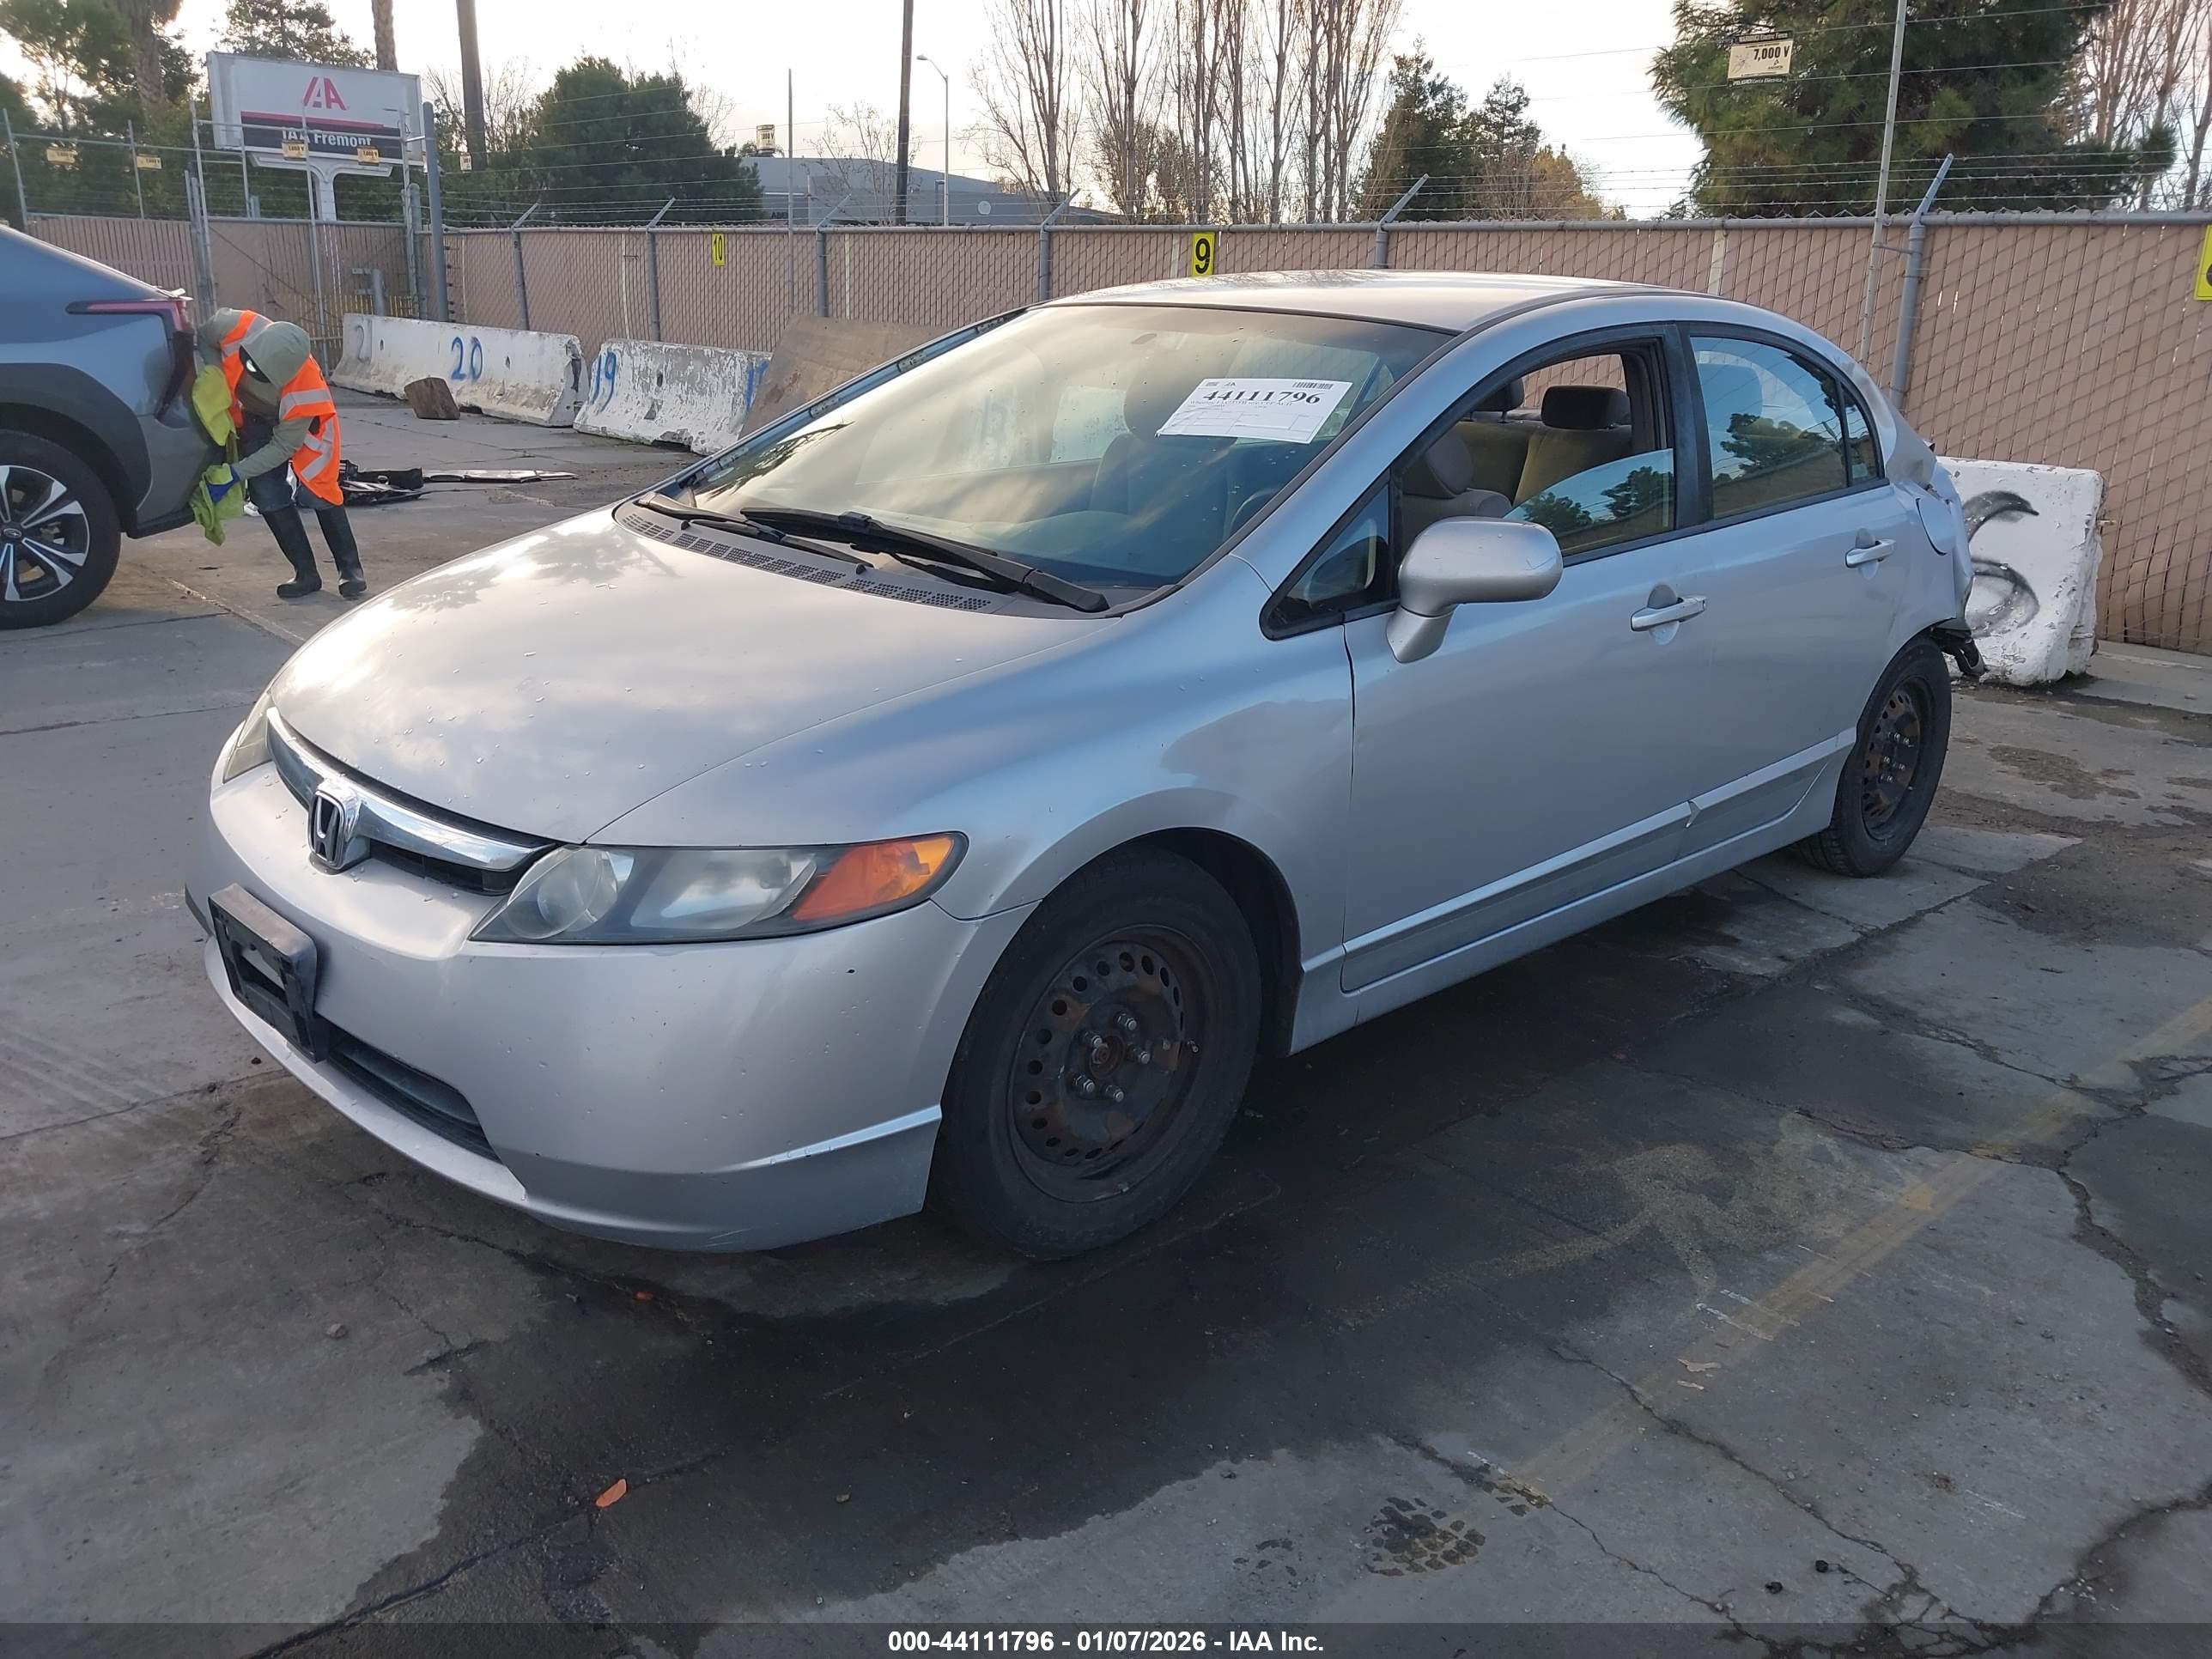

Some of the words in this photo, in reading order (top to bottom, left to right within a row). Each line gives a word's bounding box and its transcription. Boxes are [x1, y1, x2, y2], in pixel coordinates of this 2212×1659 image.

[1753, 46, 1781, 62] 7,000
[1784, 46, 1790, 58] V
[303, 76, 347, 111] IAA
[313, 133, 372, 147] Fremont
[714, 234, 723, 261] 10
[1195, 238, 1211, 274] 9
[451, 335, 484, 381] 20
[589, 349, 618, 413] 19
[1203, 390, 1326, 404] 44111796
